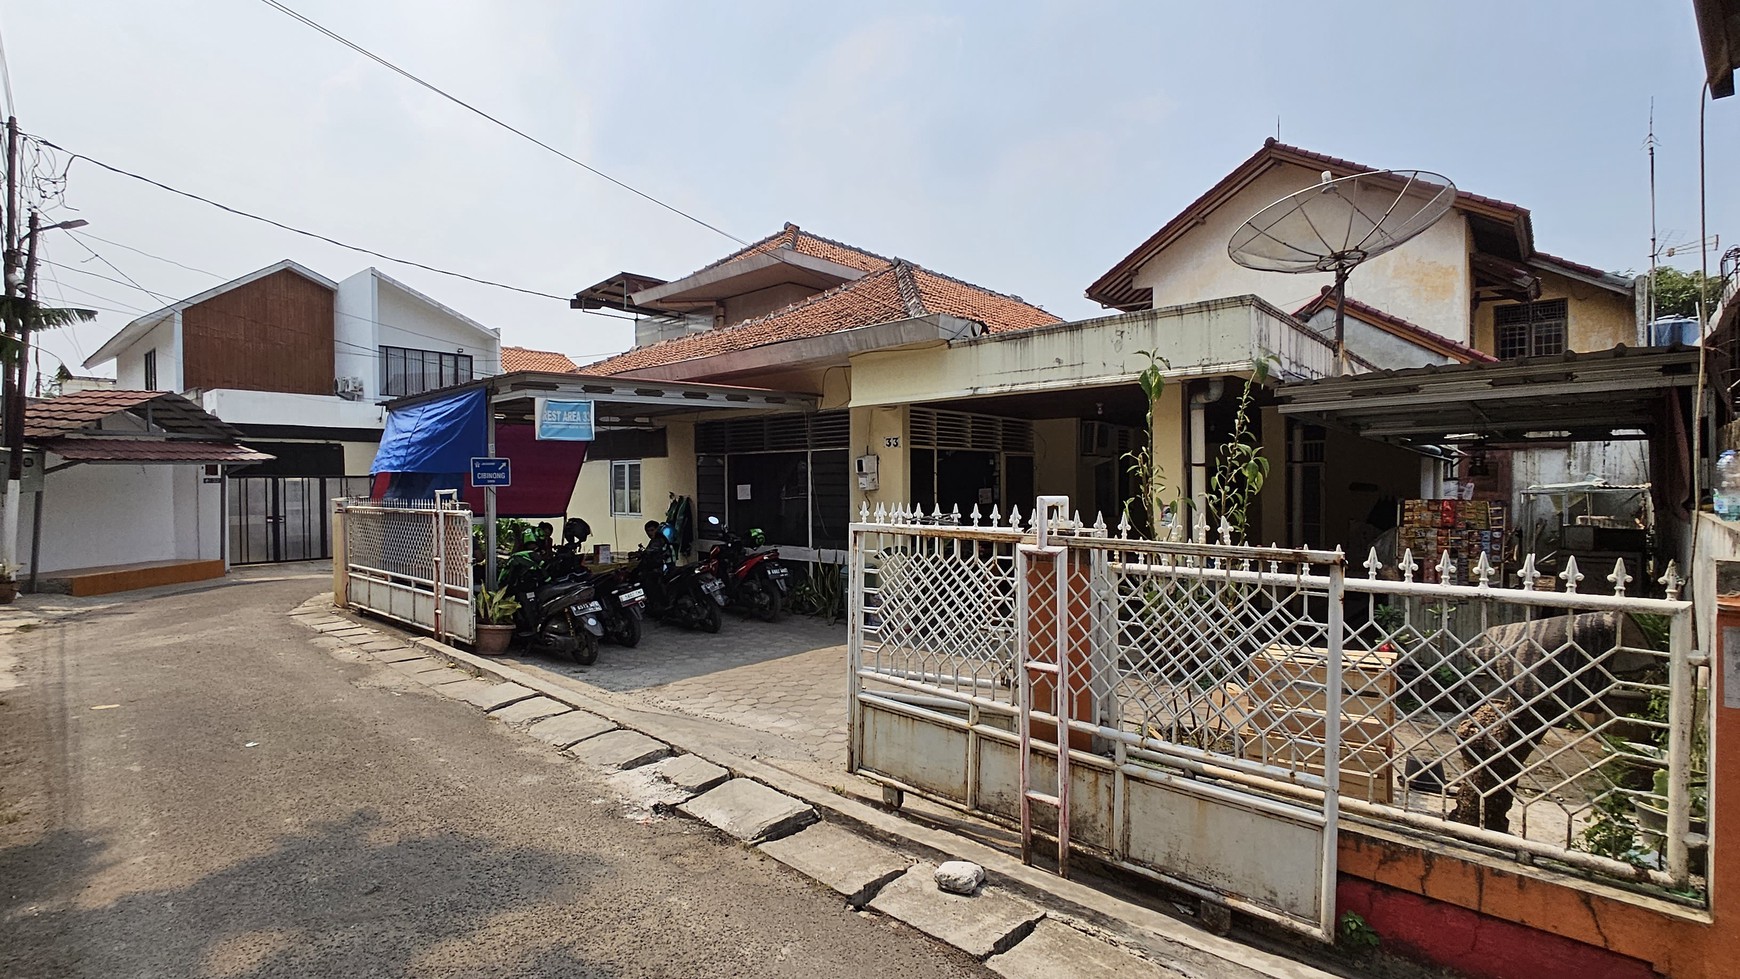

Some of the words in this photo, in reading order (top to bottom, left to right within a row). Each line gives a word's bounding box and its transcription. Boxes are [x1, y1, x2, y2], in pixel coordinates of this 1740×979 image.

[543, 410, 561, 421] REST
[563, 410, 581, 422] AREA
[885, 437, 899, 448] 33
